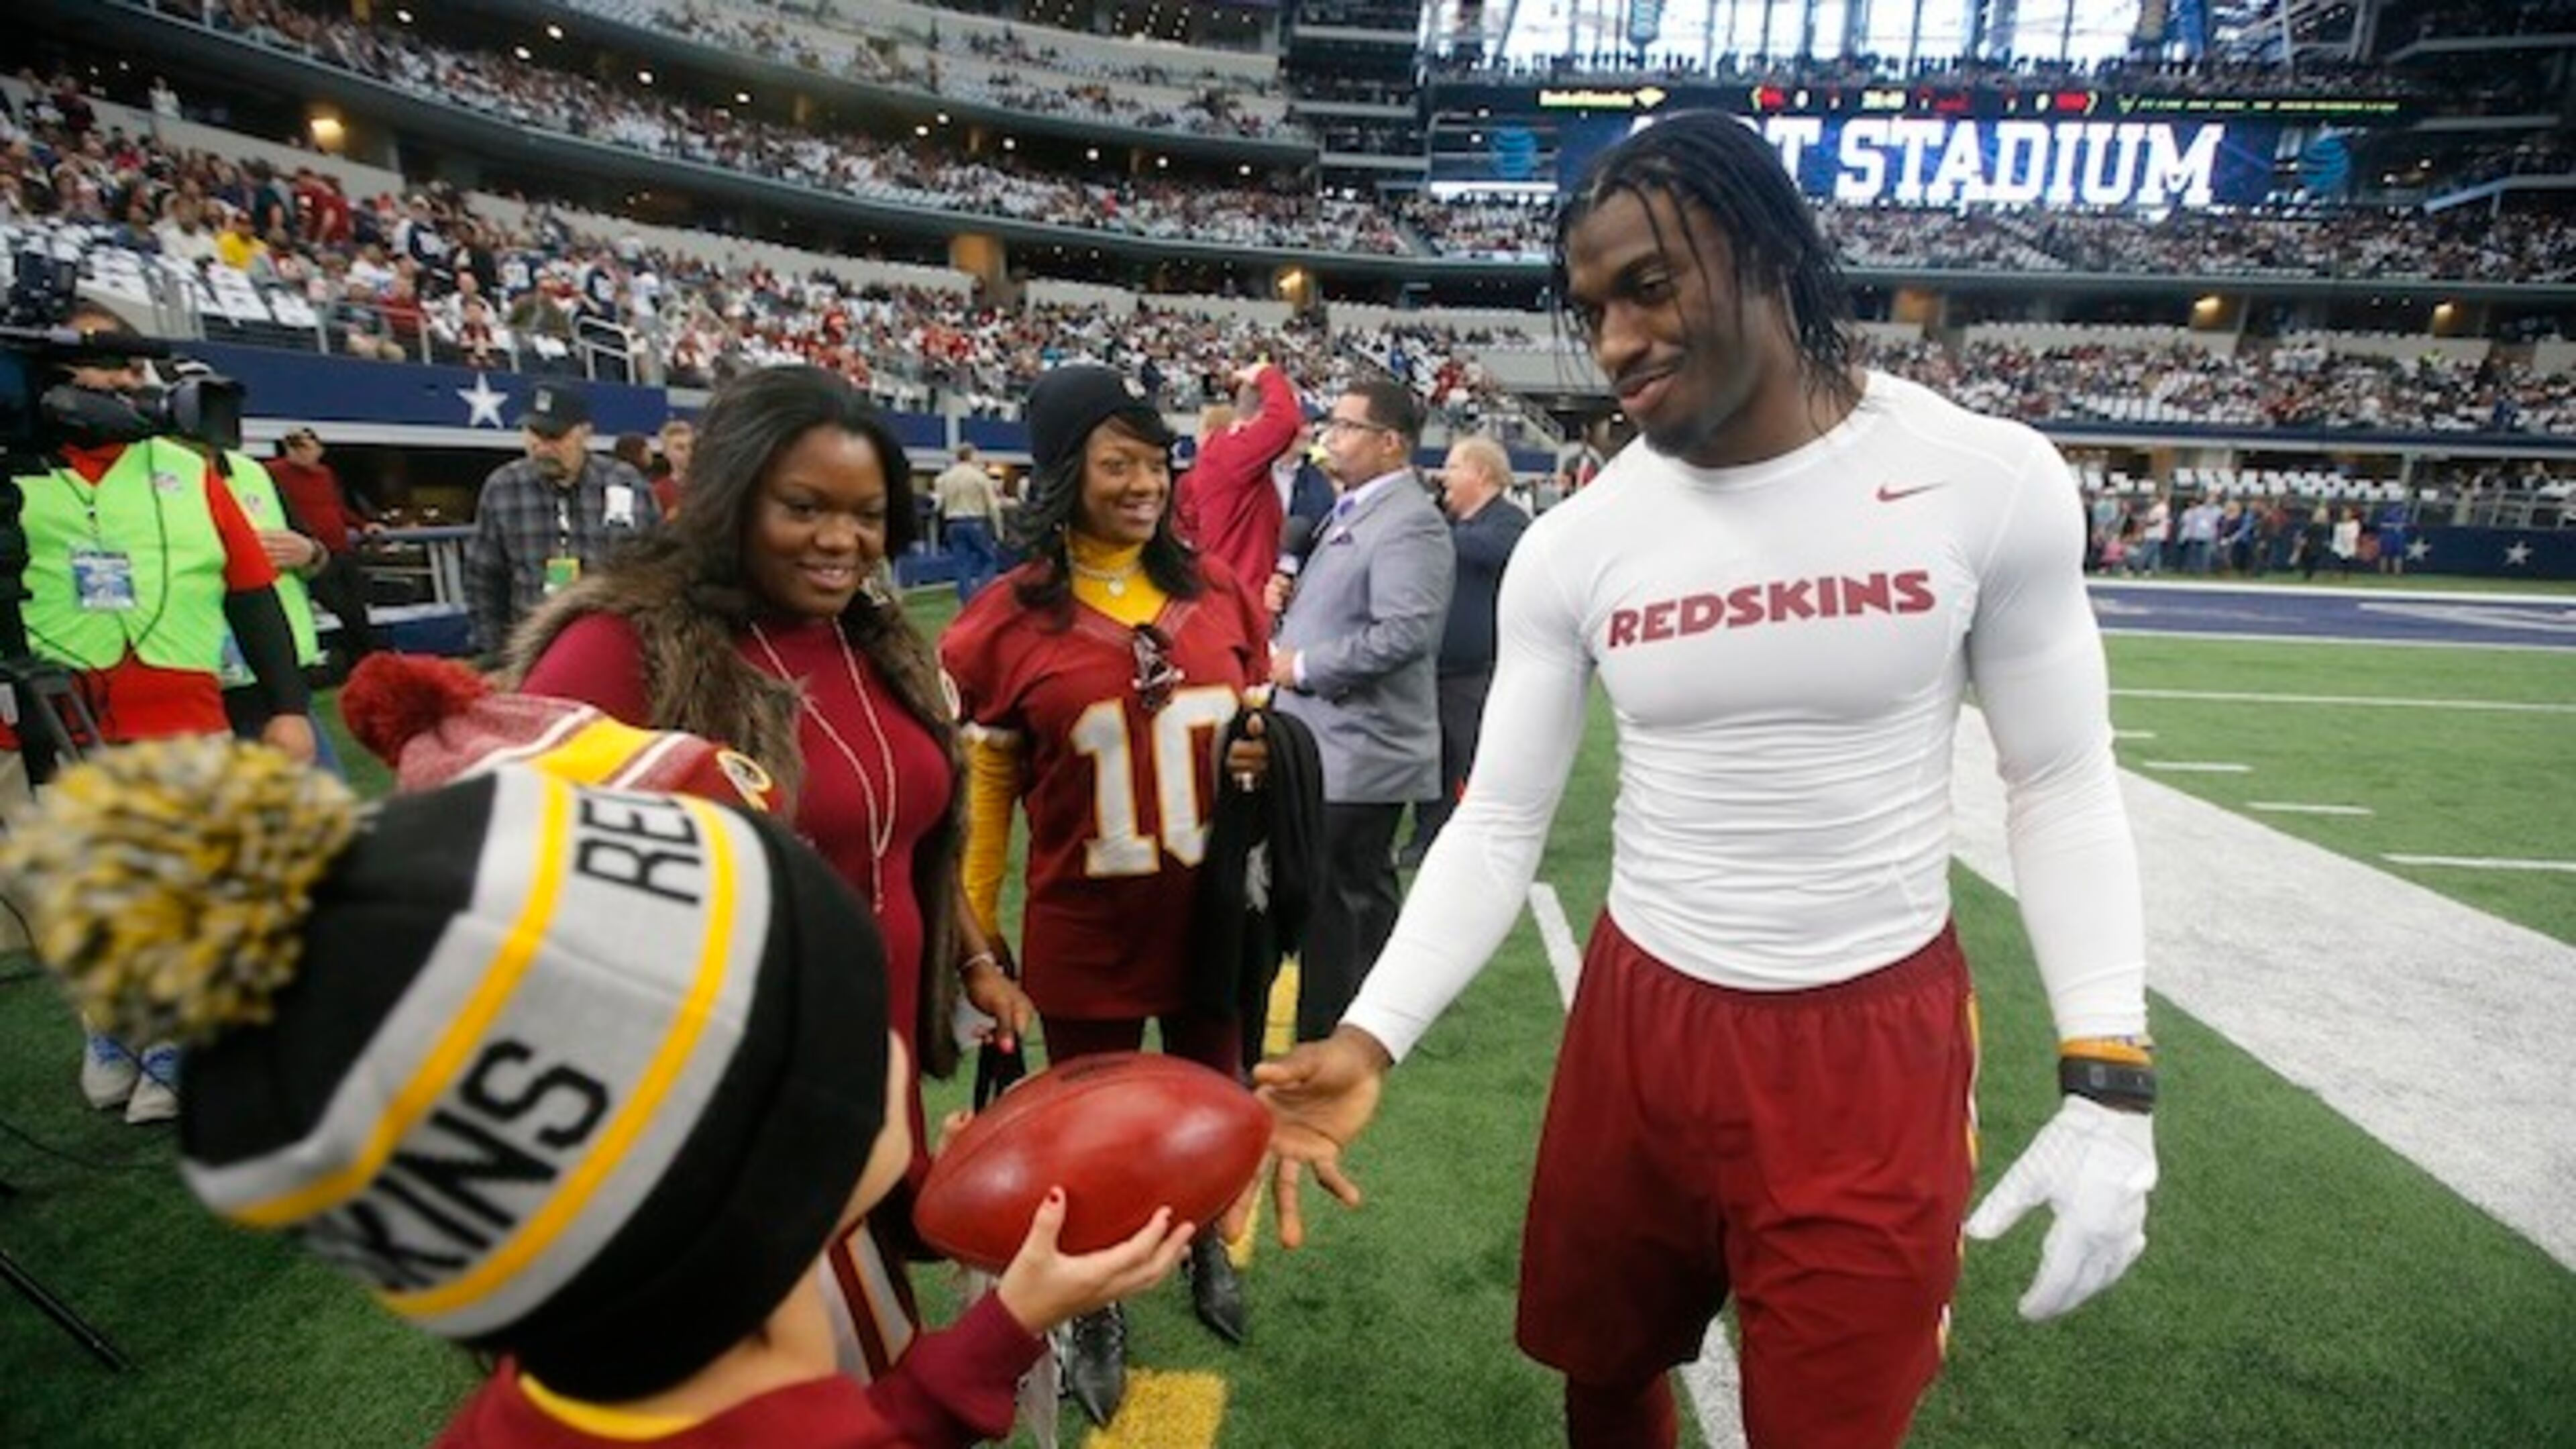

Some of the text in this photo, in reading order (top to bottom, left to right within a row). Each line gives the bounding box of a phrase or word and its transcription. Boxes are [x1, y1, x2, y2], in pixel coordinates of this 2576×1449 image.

[1834, 115, 2224, 204] STADIUM
[1609, 570, 1936, 648] REDSKINS
[1070, 684, 1240, 877] 10
